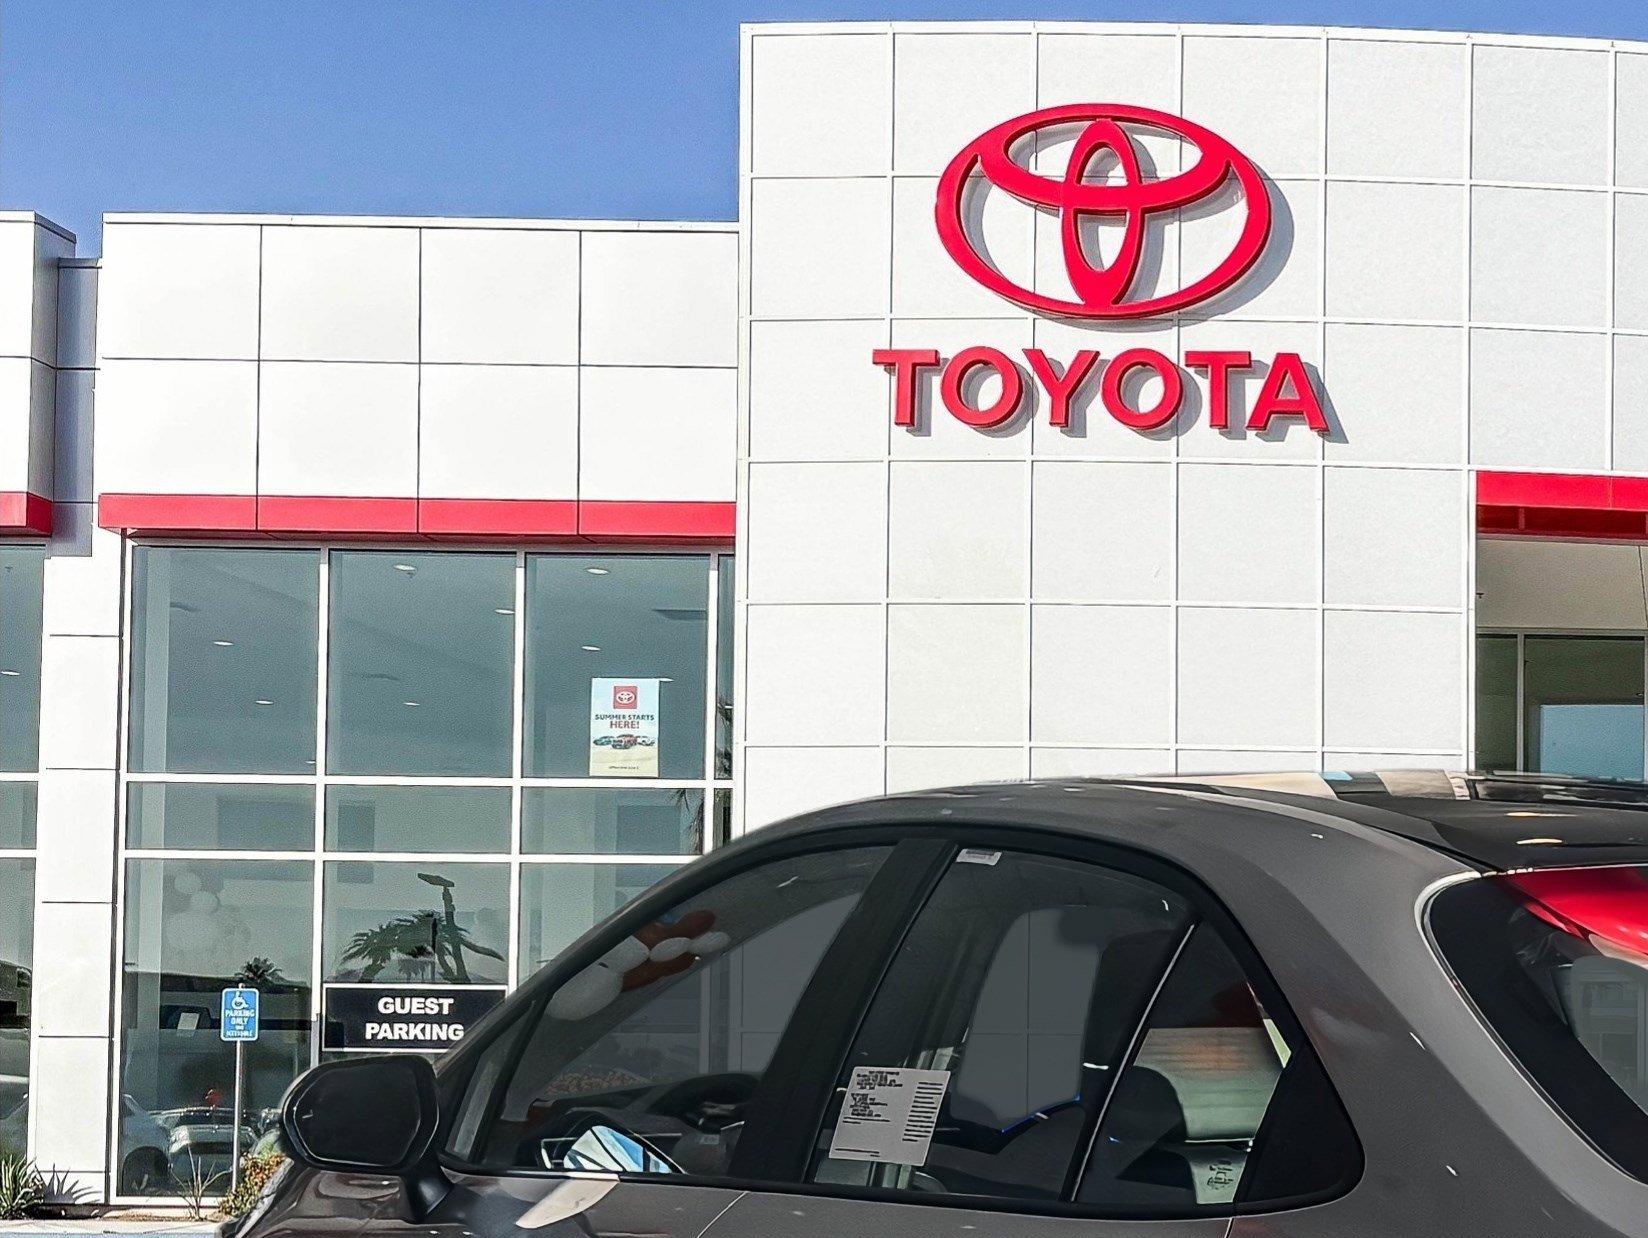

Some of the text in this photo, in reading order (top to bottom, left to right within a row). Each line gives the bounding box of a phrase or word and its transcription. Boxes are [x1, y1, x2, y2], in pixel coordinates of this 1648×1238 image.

[873, 346, 1330, 433] TOYOTA
[609, 720, 640, 729] HERE!
[378, 997, 455, 1015] GUEST
[225, 1009, 256, 1018] PARKING
[230, 1017, 249, 1025] ONLY
[365, 1023, 465, 1041] PARKING
